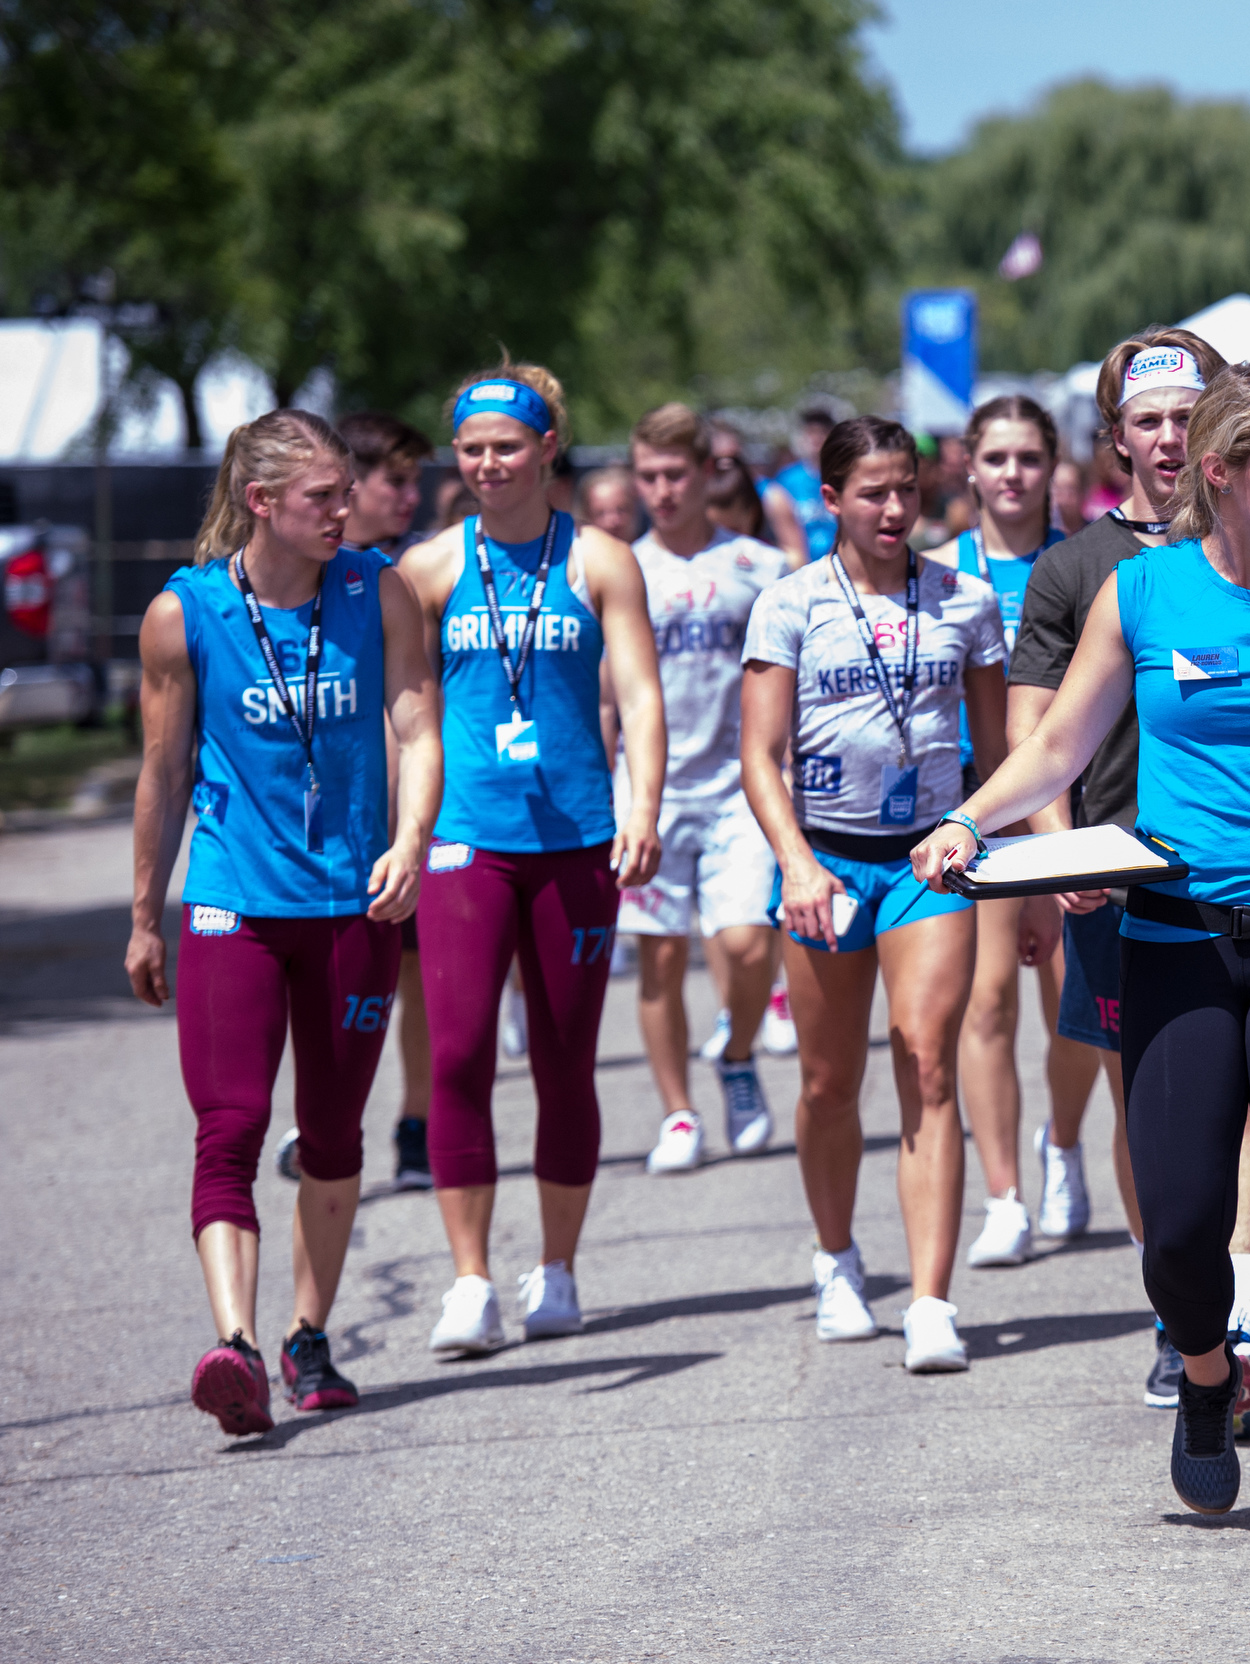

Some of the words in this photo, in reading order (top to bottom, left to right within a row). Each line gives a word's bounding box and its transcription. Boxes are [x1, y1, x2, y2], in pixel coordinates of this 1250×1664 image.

[1131, 359, 1178, 374] GAMES
[1191, 653, 1221, 662] LAUREN
[818, 661, 960, 695] KERSETER
